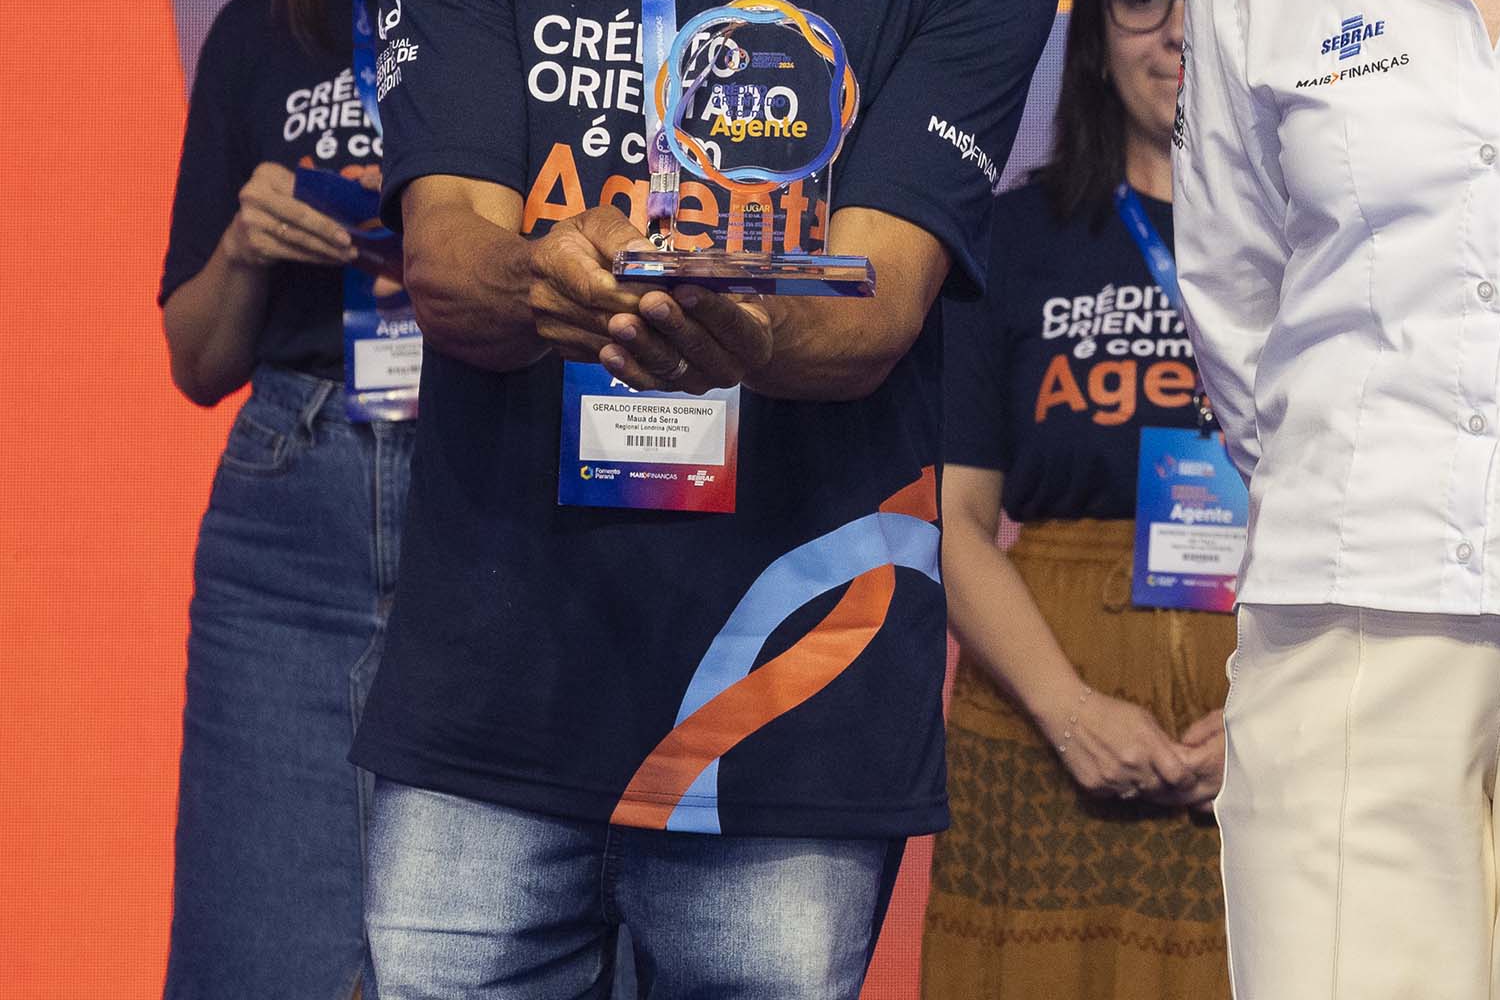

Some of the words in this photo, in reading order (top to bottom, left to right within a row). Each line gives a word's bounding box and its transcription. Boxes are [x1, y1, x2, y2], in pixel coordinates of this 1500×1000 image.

[1320, 20, 1386, 56] SEBRAE
[397, 45, 419, 63] DE
[286, 67, 361, 114] CRÉ
[581, 115, 610, 157] é
[710, 114, 808, 142] Agente
[316, 129, 338, 159] é
[743, 203, 771, 213] LUGAR
[1073, 333, 1098, 360] é
[1106, 338, 1194, 358] com
[1035, 353, 1213, 426] Age
[592, 403, 631, 412] GERALDO
[632, 405, 671, 415] FERREIRA
[672, 406, 714, 416] SOBRINHO
[648, 415, 658, 423] da
[659, 416, 679, 424] Serra
[615, 423, 640, 431] Regional
[640, 424, 666, 432] Londrina
